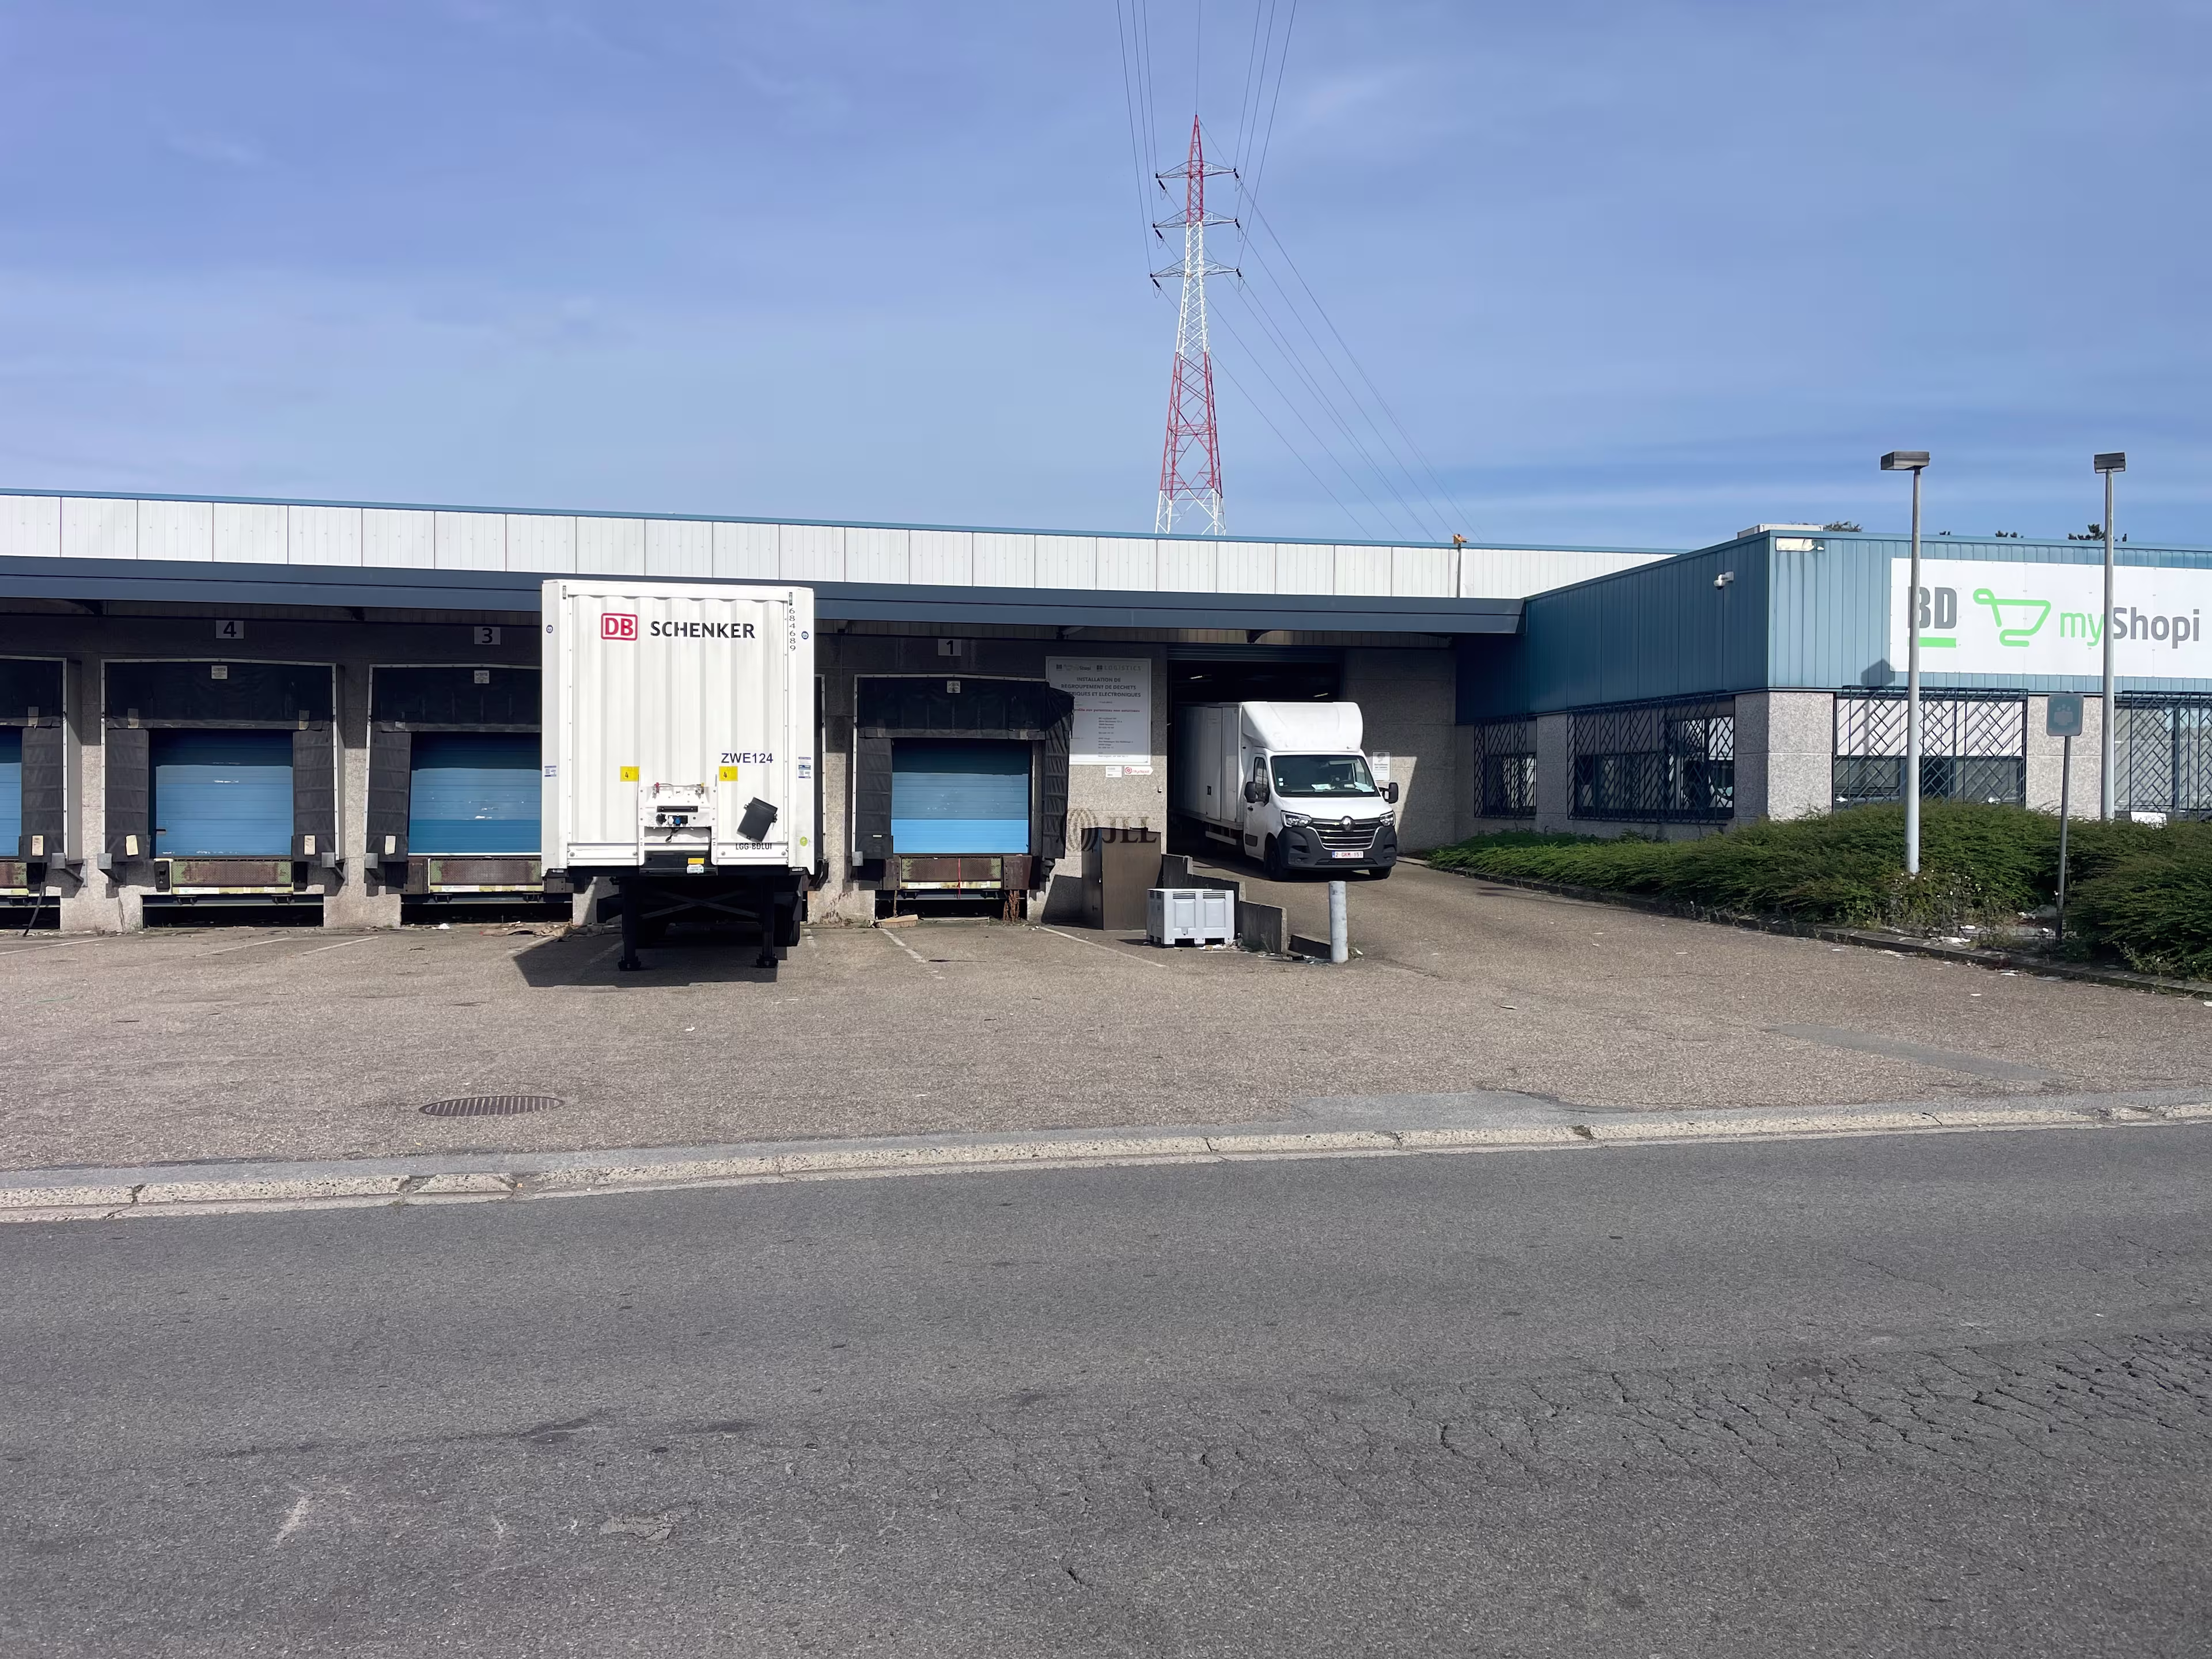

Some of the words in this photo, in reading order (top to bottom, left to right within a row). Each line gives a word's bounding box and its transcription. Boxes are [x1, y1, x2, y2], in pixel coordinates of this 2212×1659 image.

[1907, 586, 1957, 628] BD
[223, 621, 237, 637] 4
[482, 627, 493, 643] 3
[605, 618, 634, 636] DB
[650, 620, 755, 639] SCHENKER
[946, 640, 953, 655] 1
[721, 752, 774, 764] ZWE124
